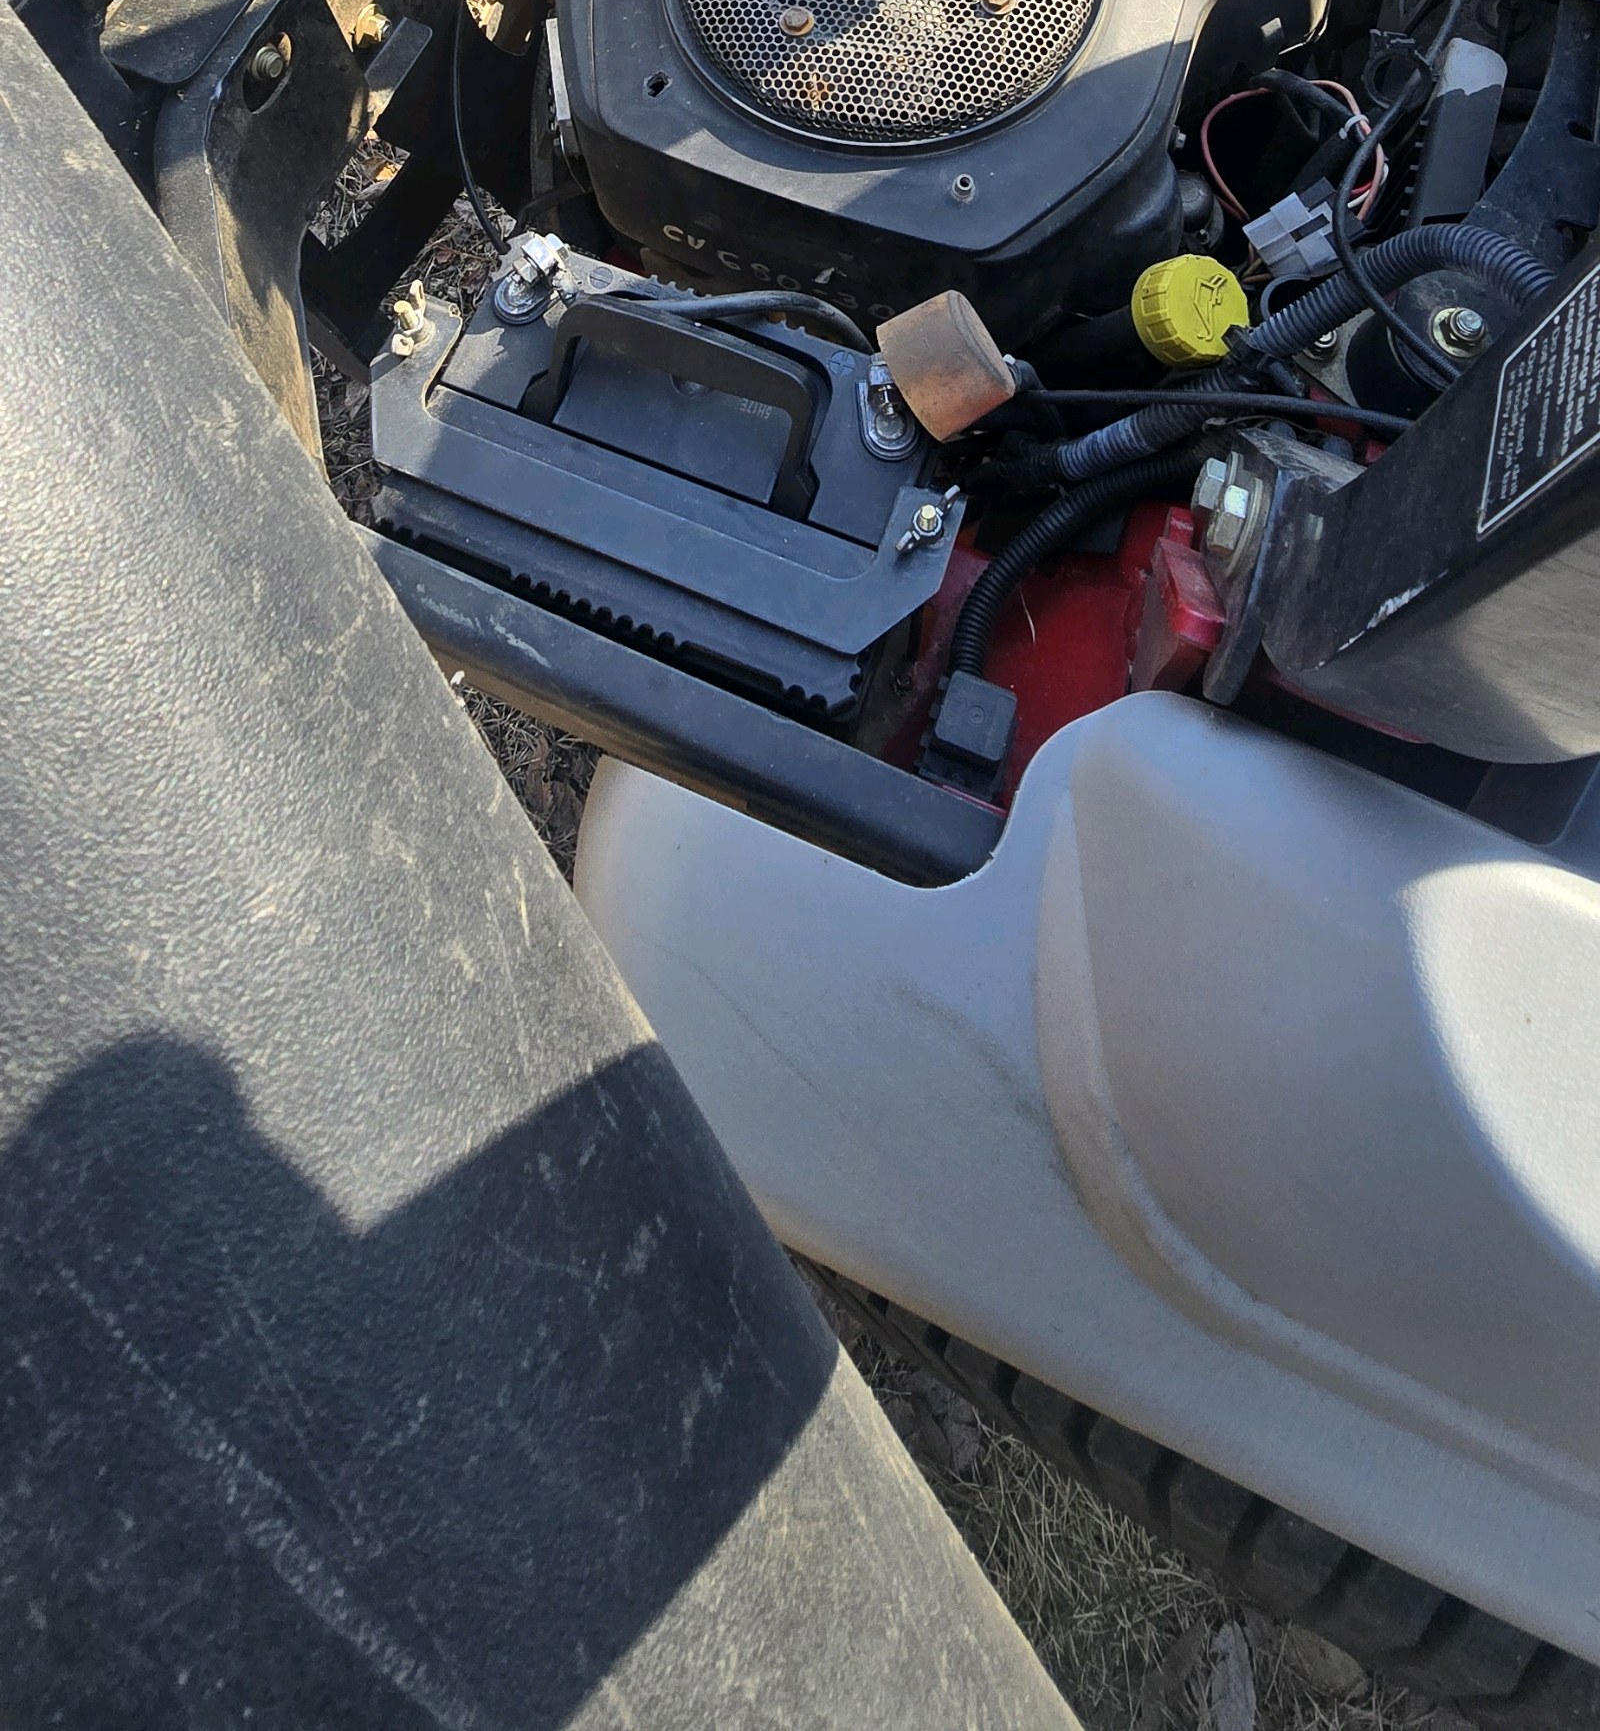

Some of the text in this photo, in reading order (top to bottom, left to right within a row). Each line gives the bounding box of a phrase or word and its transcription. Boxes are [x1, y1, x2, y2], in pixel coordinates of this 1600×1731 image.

[1527, 350, 1536, 375] Do
[1540, 338, 1548, 363] roll
[1574, 276, 1600, 434] fuel leakage and
[1561, 289, 1587, 456] violate emissions
[1502, 389, 1513, 418] any
[1522, 379, 1532, 410] not
[1537, 326, 1560, 456] Do not remove
[1501, 471, 1510, 499] bar
